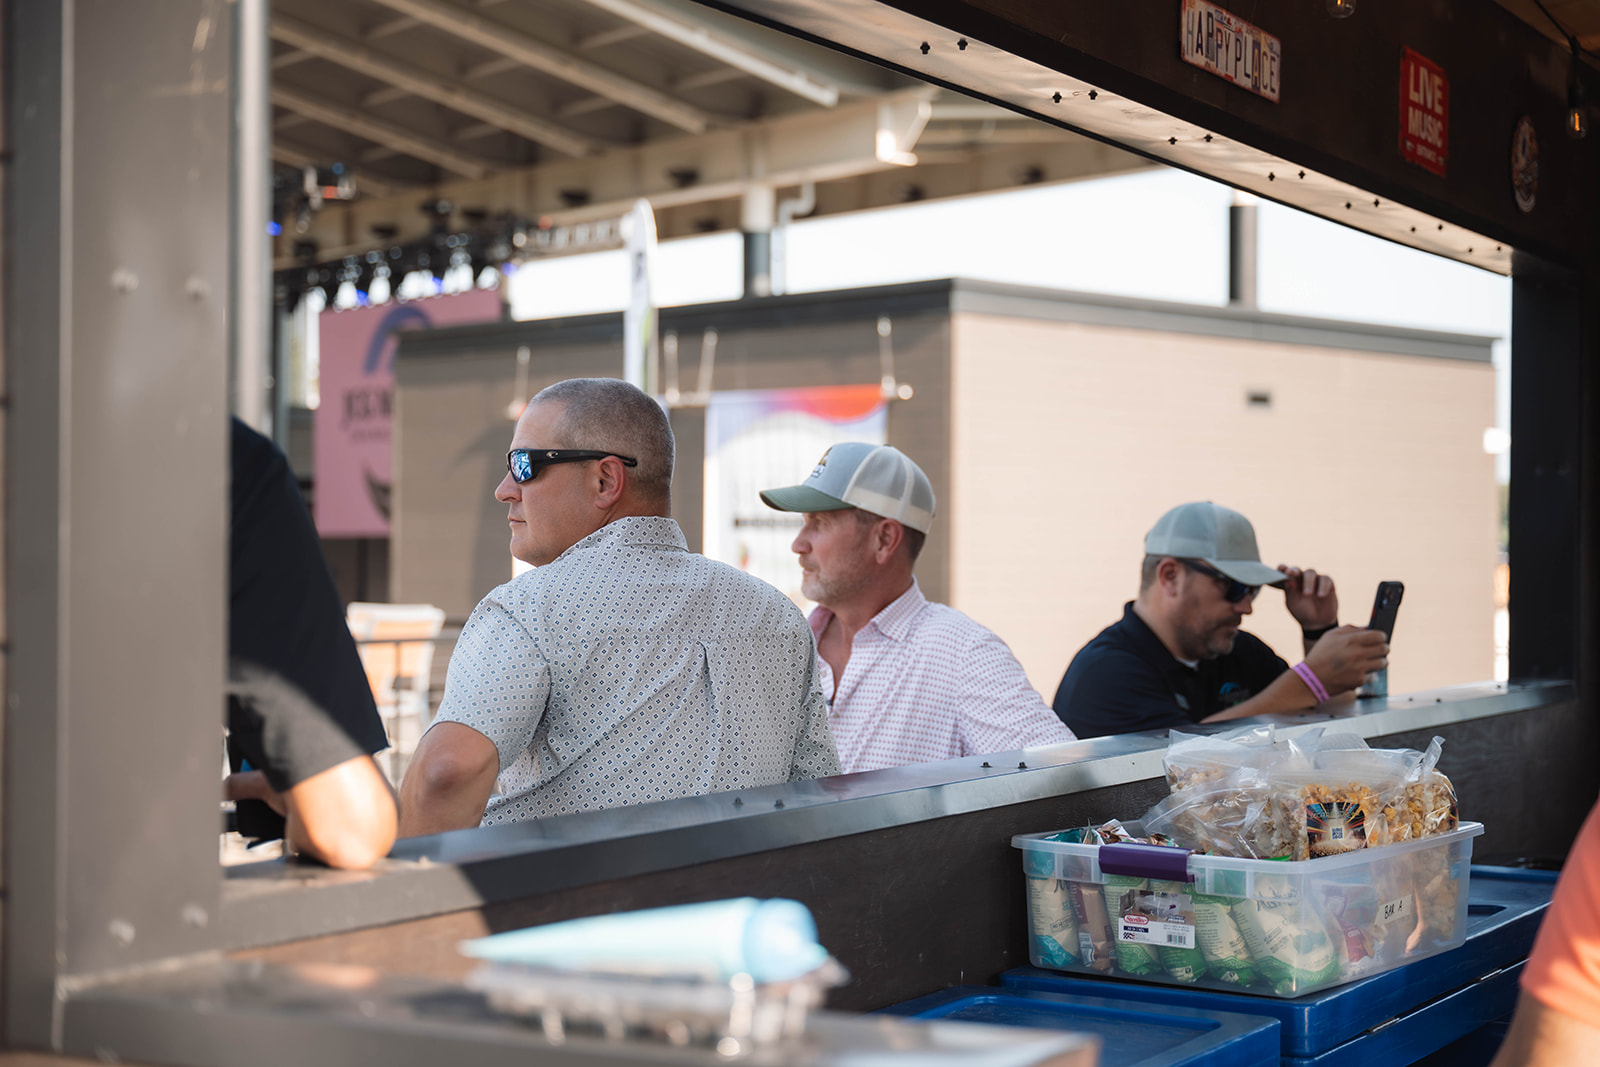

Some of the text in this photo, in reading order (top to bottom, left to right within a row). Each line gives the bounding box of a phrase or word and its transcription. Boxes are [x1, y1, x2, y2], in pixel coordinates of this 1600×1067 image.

[1186, 9, 1277, 94] HAPPY PLACE
[1409, 60, 1443, 116] LIVE
[1408, 105, 1443, 149] MUSIC
